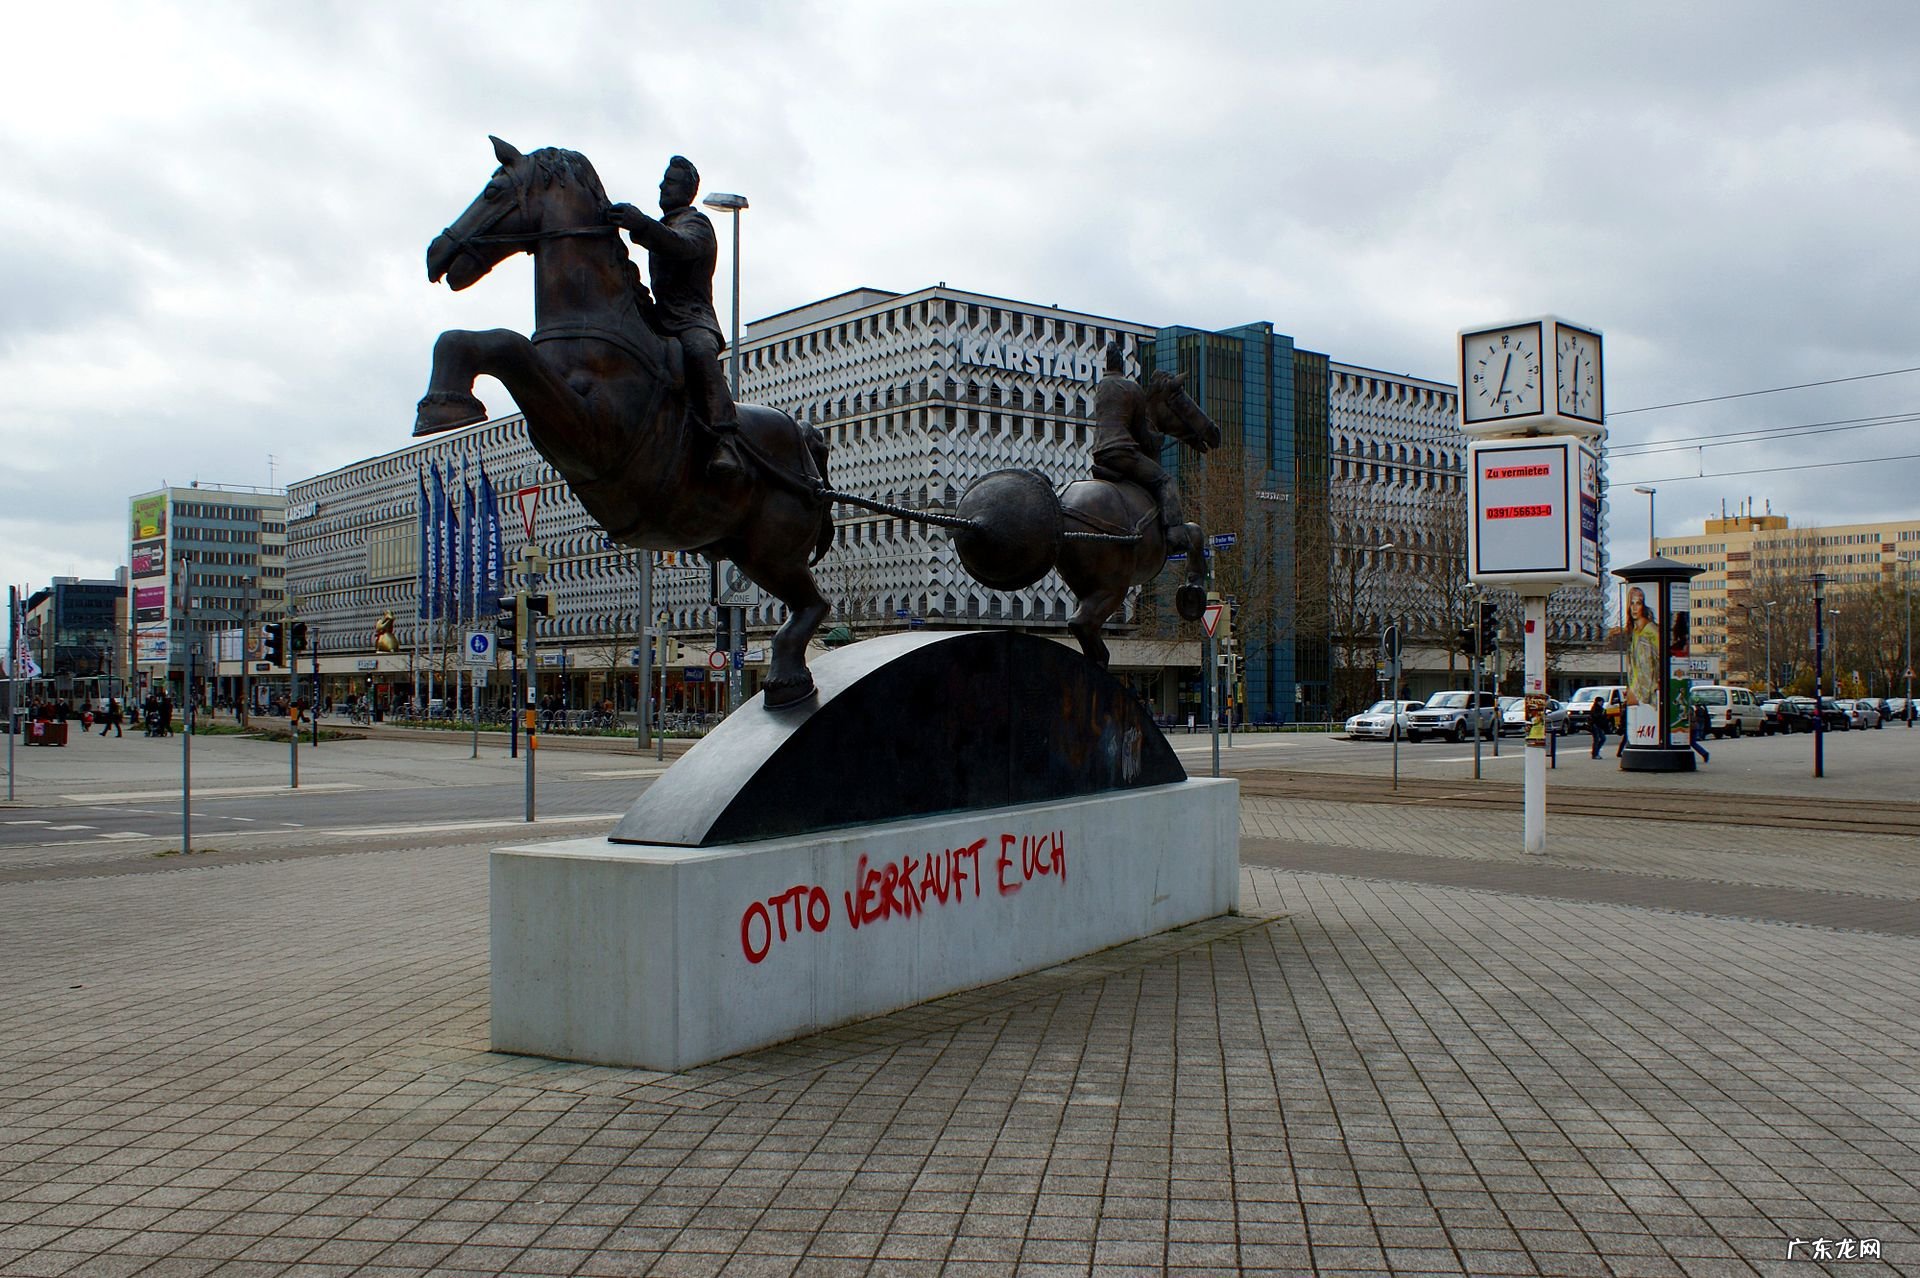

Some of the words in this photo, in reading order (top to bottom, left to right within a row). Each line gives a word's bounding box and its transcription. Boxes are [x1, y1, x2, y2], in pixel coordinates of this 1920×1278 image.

[1501, 335, 1509, 345] 12
[961, 337, 1107, 384] KARSTADT
[1533, 365, 1539, 374] 3
[1473, 374, 1479, 383] 9
[1503, 403, 1510, 414] 6
[1487, 468, 1499, 478] Zu
[1501, 466, 1550, 477] vermieten
[1487, 504, 1552, 519] 0391/56633-0
[488, 514, 497, 591] KARSTADT
[729, 594, 750, 603] ZONE
[741, 885, 830, 964] OTTO
[845, 837, 987, 929] VERKAUFT
[997, 830, 1067, 896] EUCH
